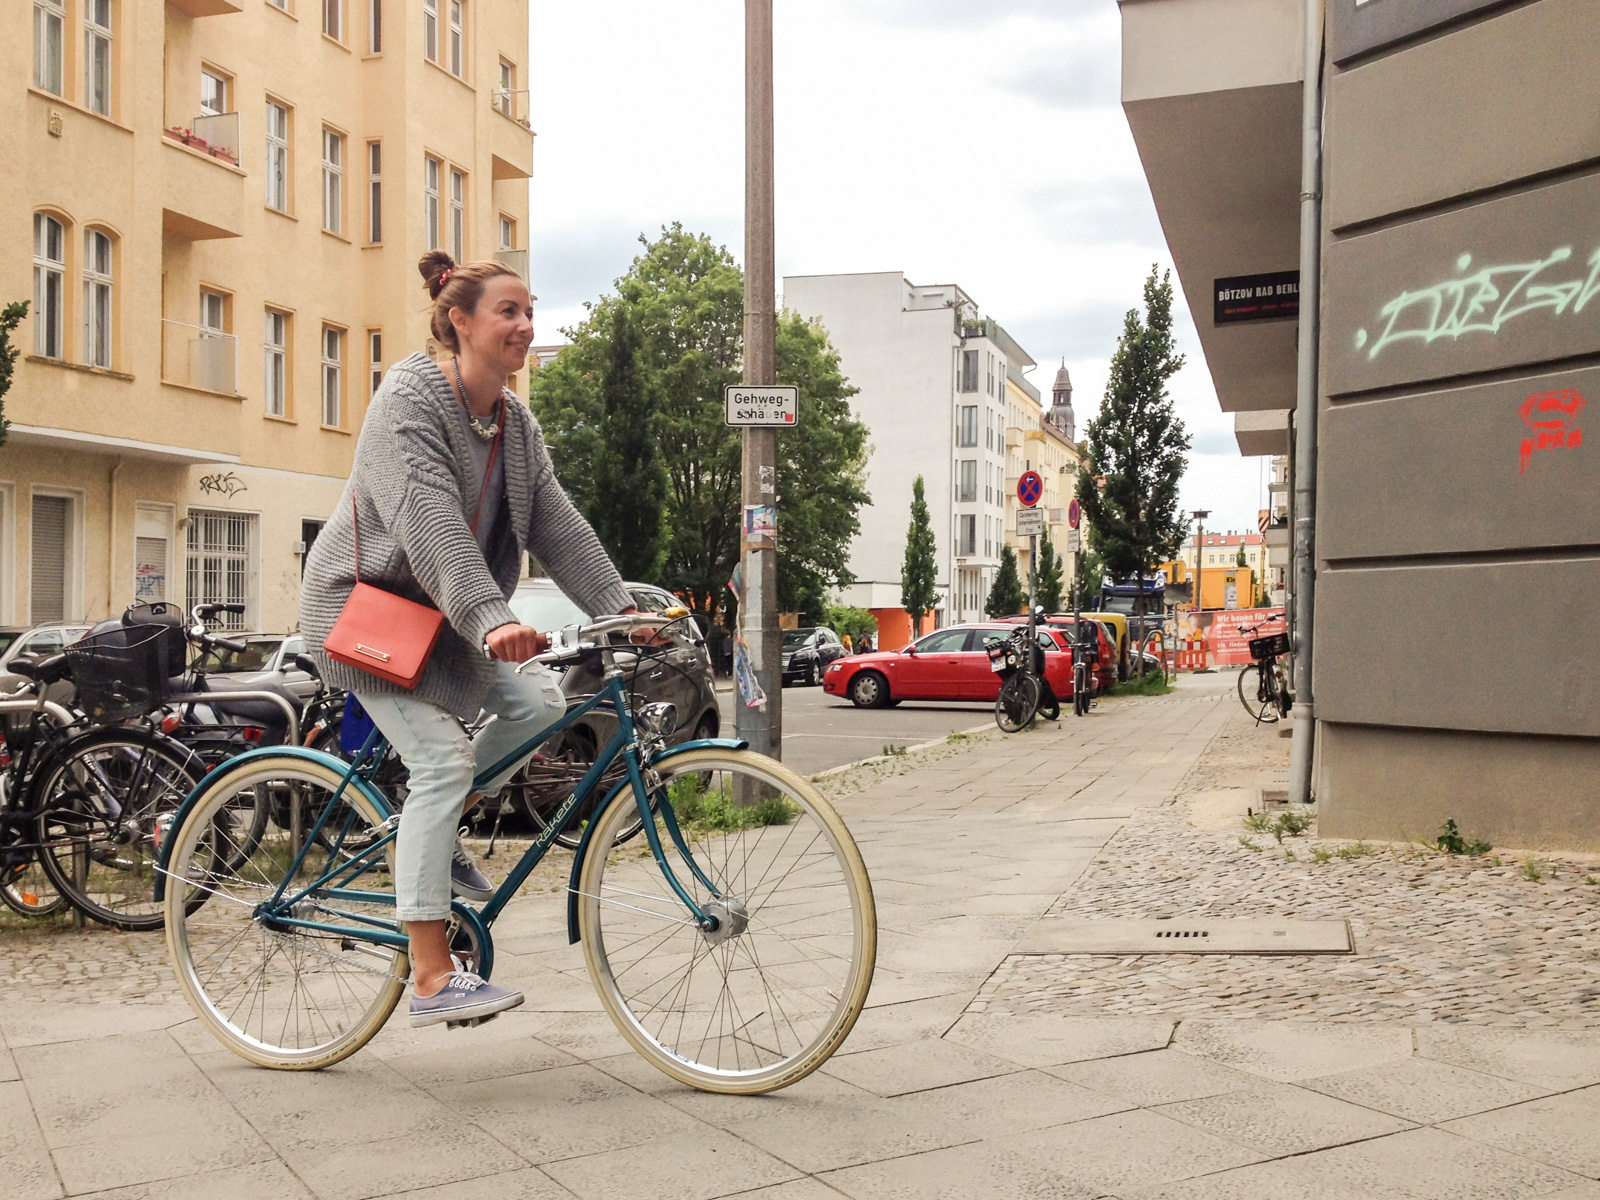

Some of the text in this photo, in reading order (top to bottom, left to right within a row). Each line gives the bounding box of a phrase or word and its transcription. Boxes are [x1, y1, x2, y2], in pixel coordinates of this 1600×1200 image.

[1218, 288, 1253, 302] BÖTZOW
[1255, 286, 1274, 297] RAD
[734, 393, 789, 407] Gehweg-
[535, 793, 577, 848] Rakete
